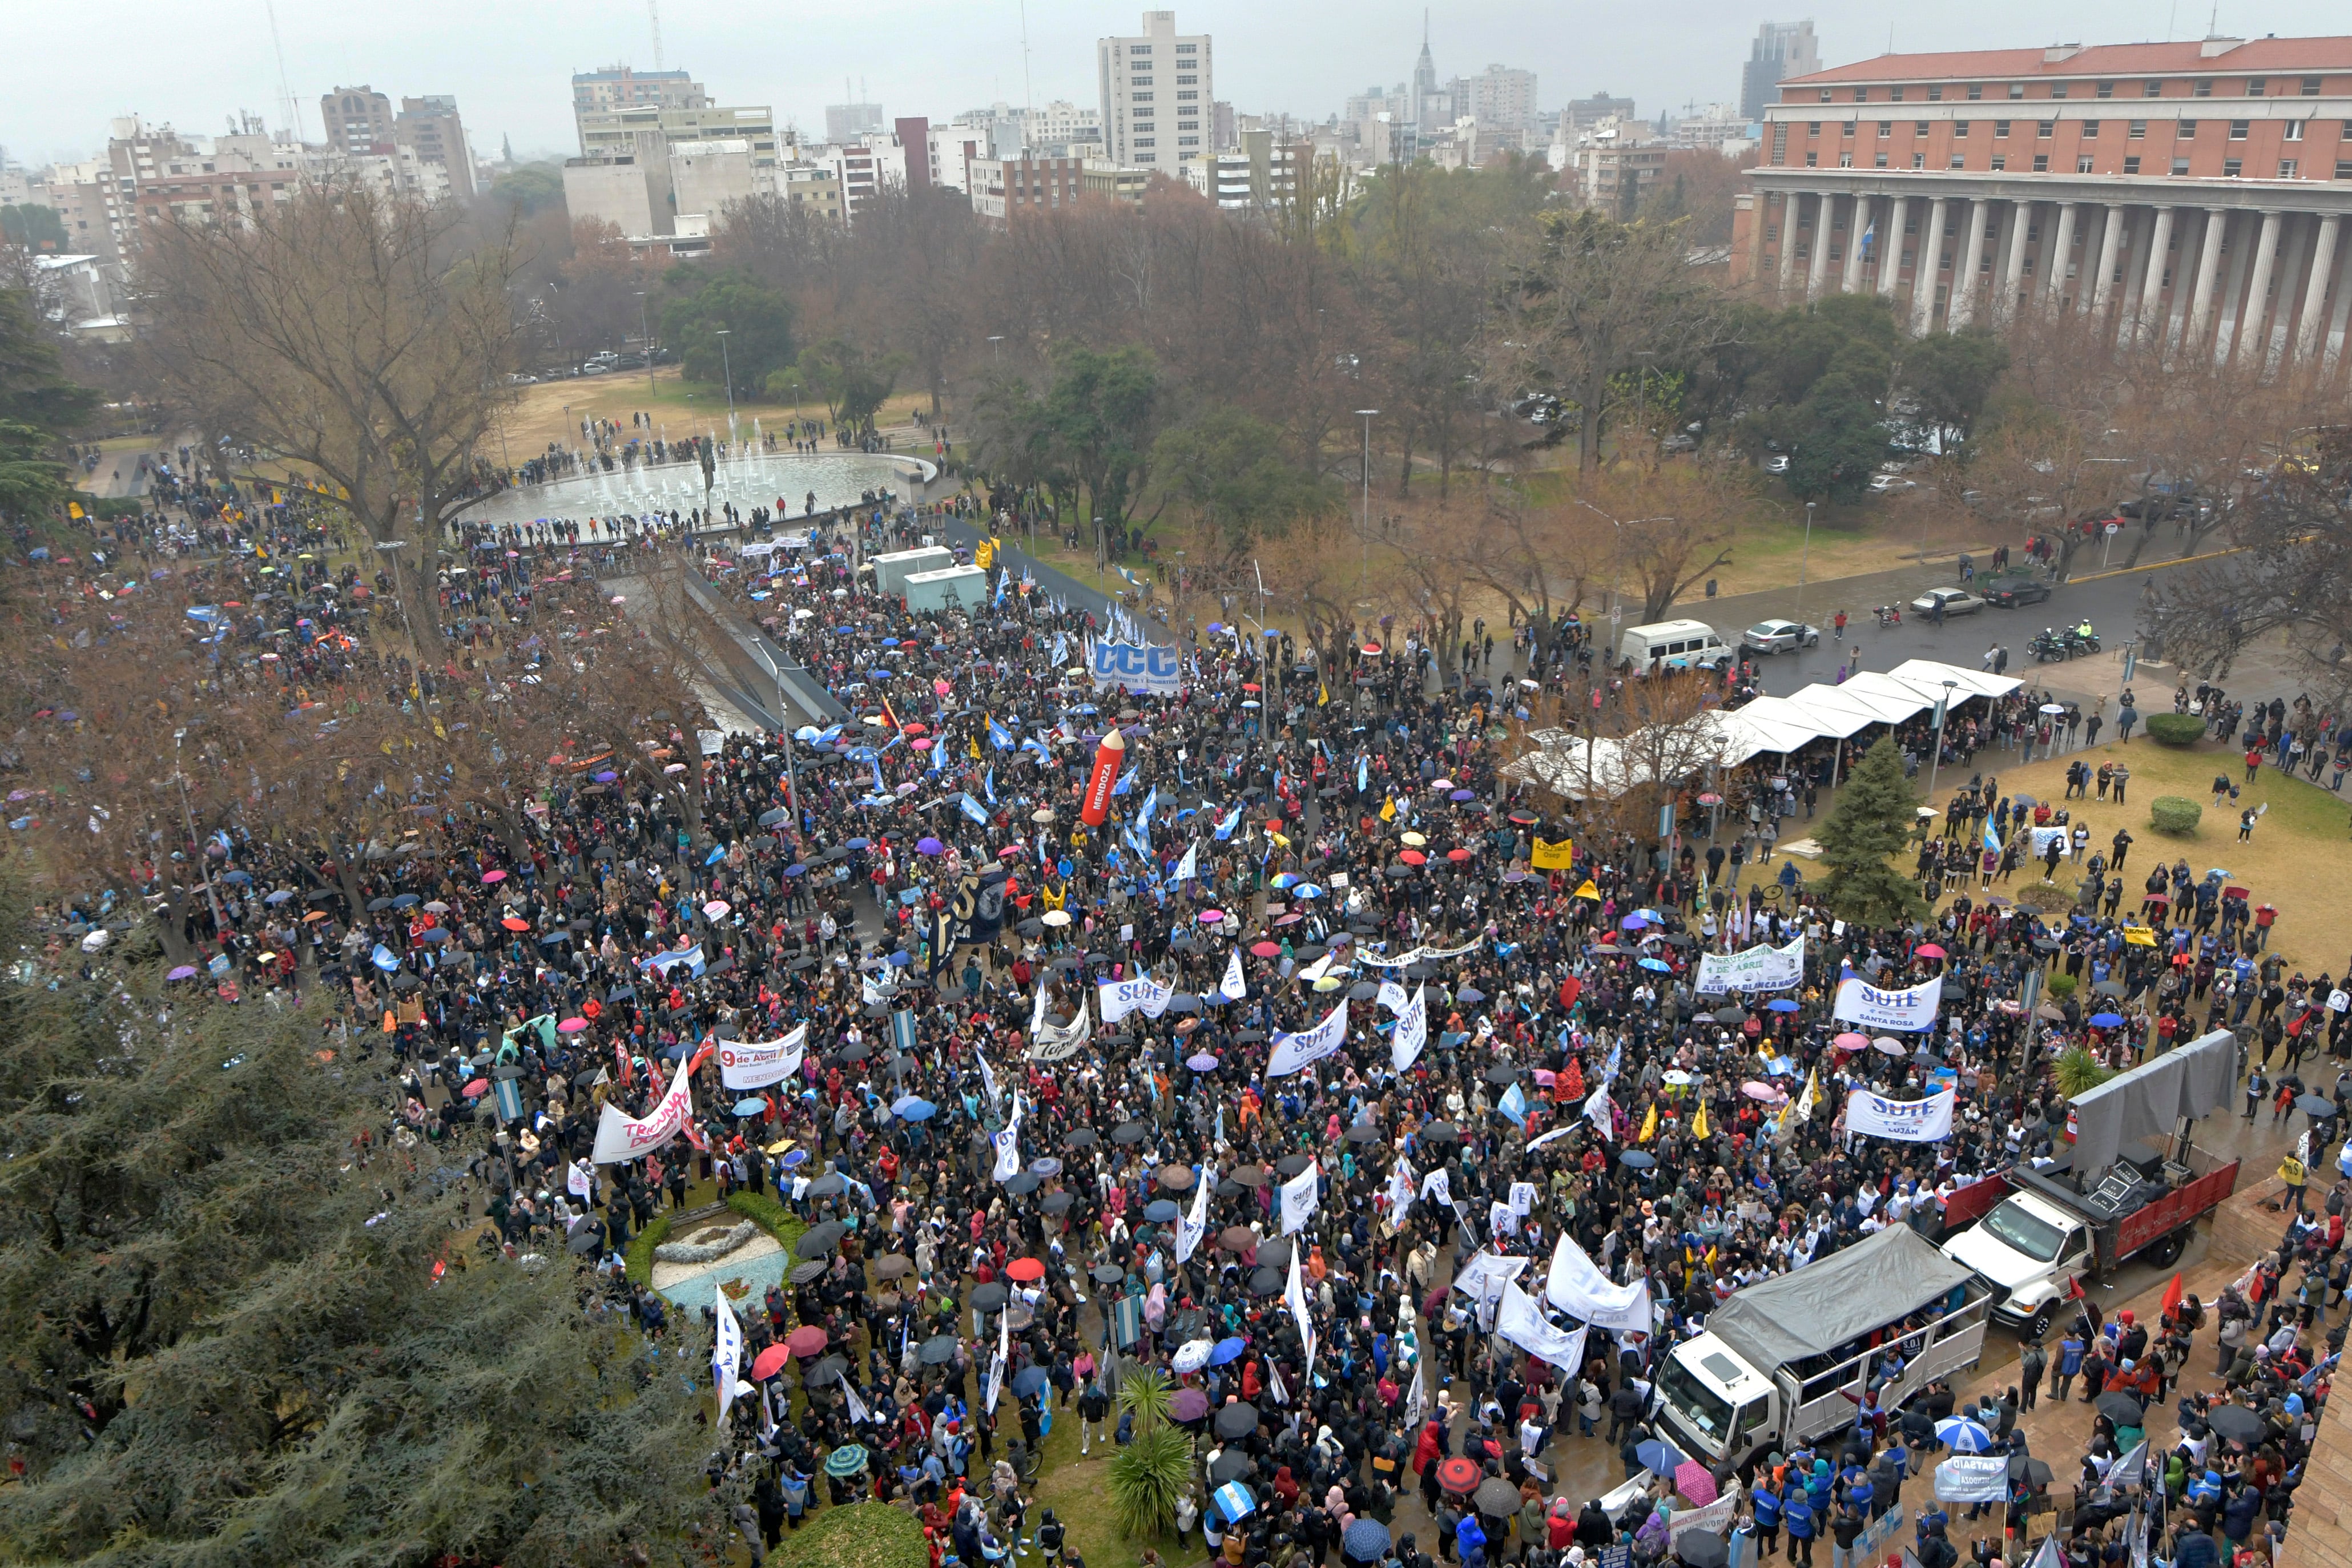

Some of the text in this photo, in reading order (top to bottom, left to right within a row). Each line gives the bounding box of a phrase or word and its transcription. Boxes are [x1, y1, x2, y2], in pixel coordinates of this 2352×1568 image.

[1096, 644, 1177, 676] CCC
[1113, 675, 1138, 683] CLASISTA
[1093, 763, 1112, 810] MENDOZA
[1735, 960, 1764, 972] ABRIL
[1118, 982, 1164, 1002] SUTE
[1742, 981, 1777, 990] BLANCA
[1861, 986, 1919, 1007] SUTE
[1400, 997, 1423, 1039] SUTE
[1859, 1014, 1888, 1025] SANTA
[1294, 1019, 1334, 1053] SUTE
[721, 1050, 735, 1067] 9
[753, 1053, 776, 1062] Abril
[743, 1066, 790, 1083] MENDOZA
[1872, 1098, 1934, 1117] SUTE
[1888, 1127, 1918, 1135] LUJÁN
[1292, 1182, 1314, 1202] SUTE
[1436, 1180, 1447, 1194] U
[1519, 1192, 1526, 1204] E
[1499, 1215, 1507, 1227] S
